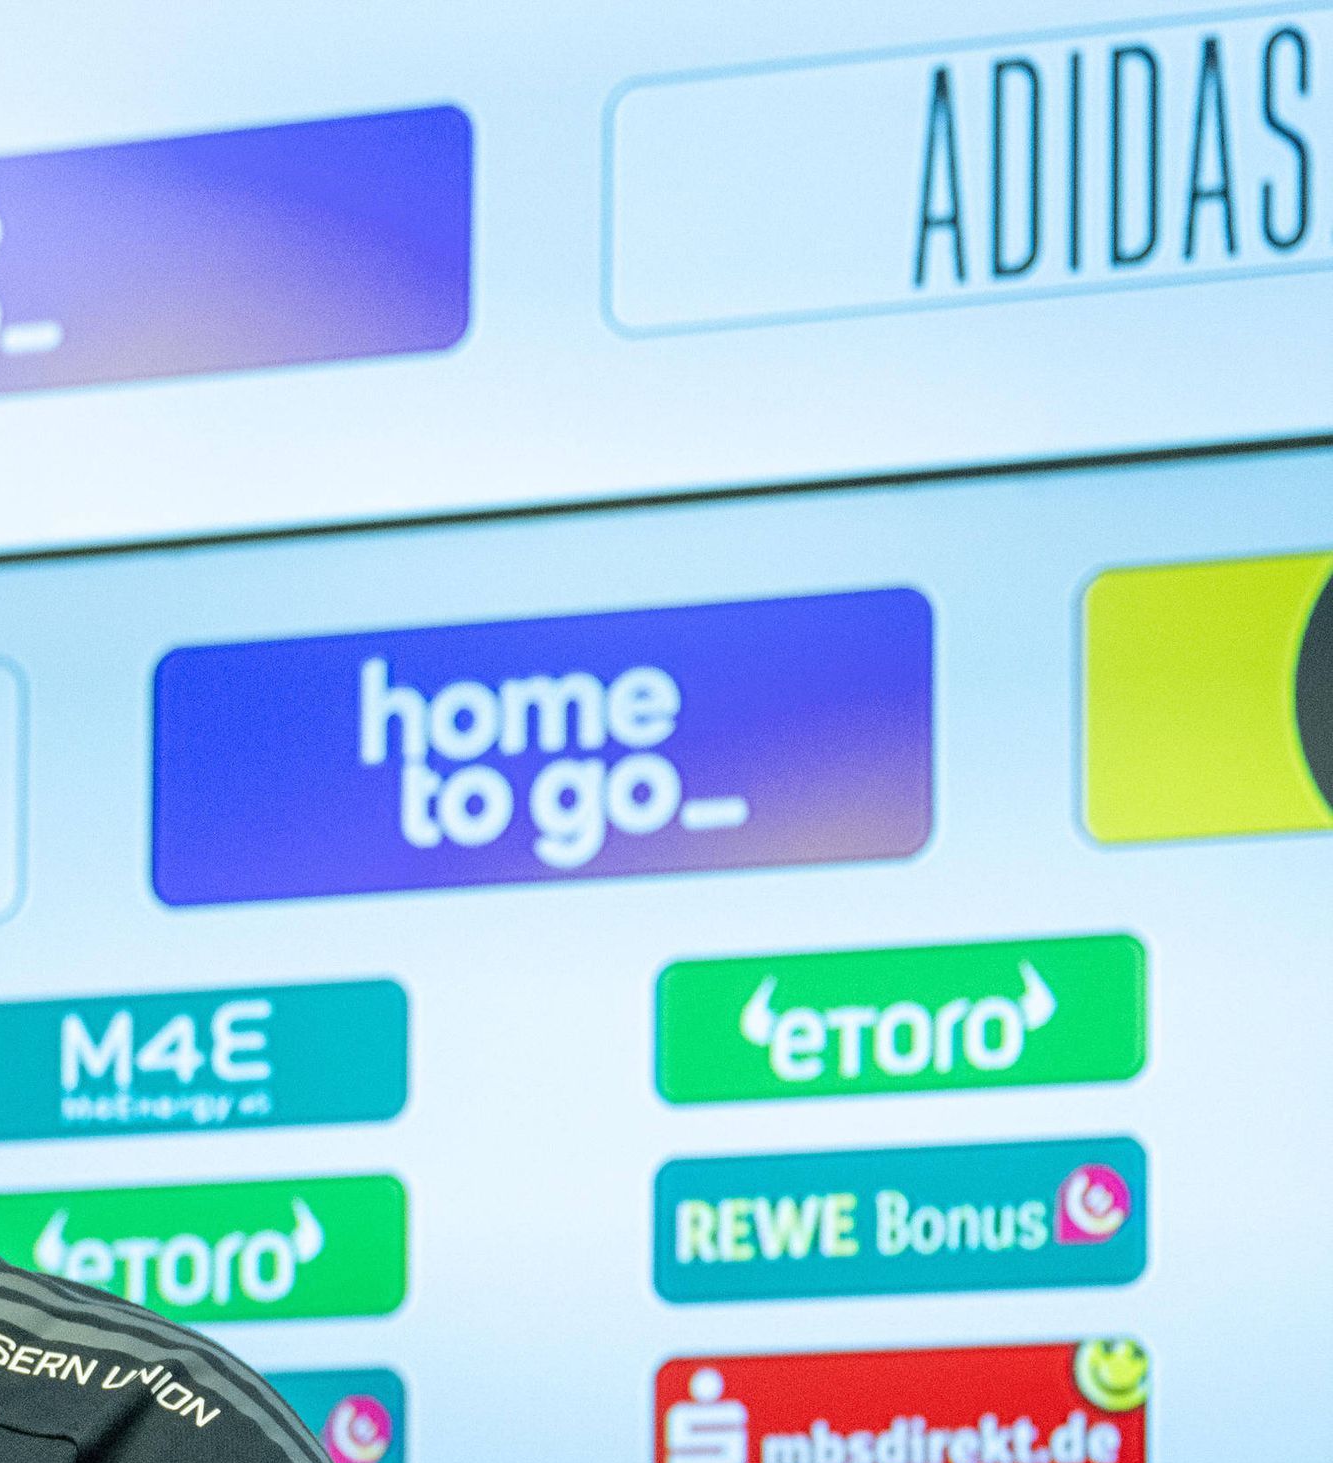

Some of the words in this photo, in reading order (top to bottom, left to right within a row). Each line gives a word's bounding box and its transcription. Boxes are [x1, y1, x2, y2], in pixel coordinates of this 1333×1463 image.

[912, 23, 1311, 289] ADIDAS
[360, 656, 681, 766] home
[401, 760, 514, 849] to
[60, 999, 272, 1093] M4E
[675, 1192, 860, 1264] REWE
[875, 1190, 1049, 1257] Bonus
[101, 1363, 222, 1428] UNION
